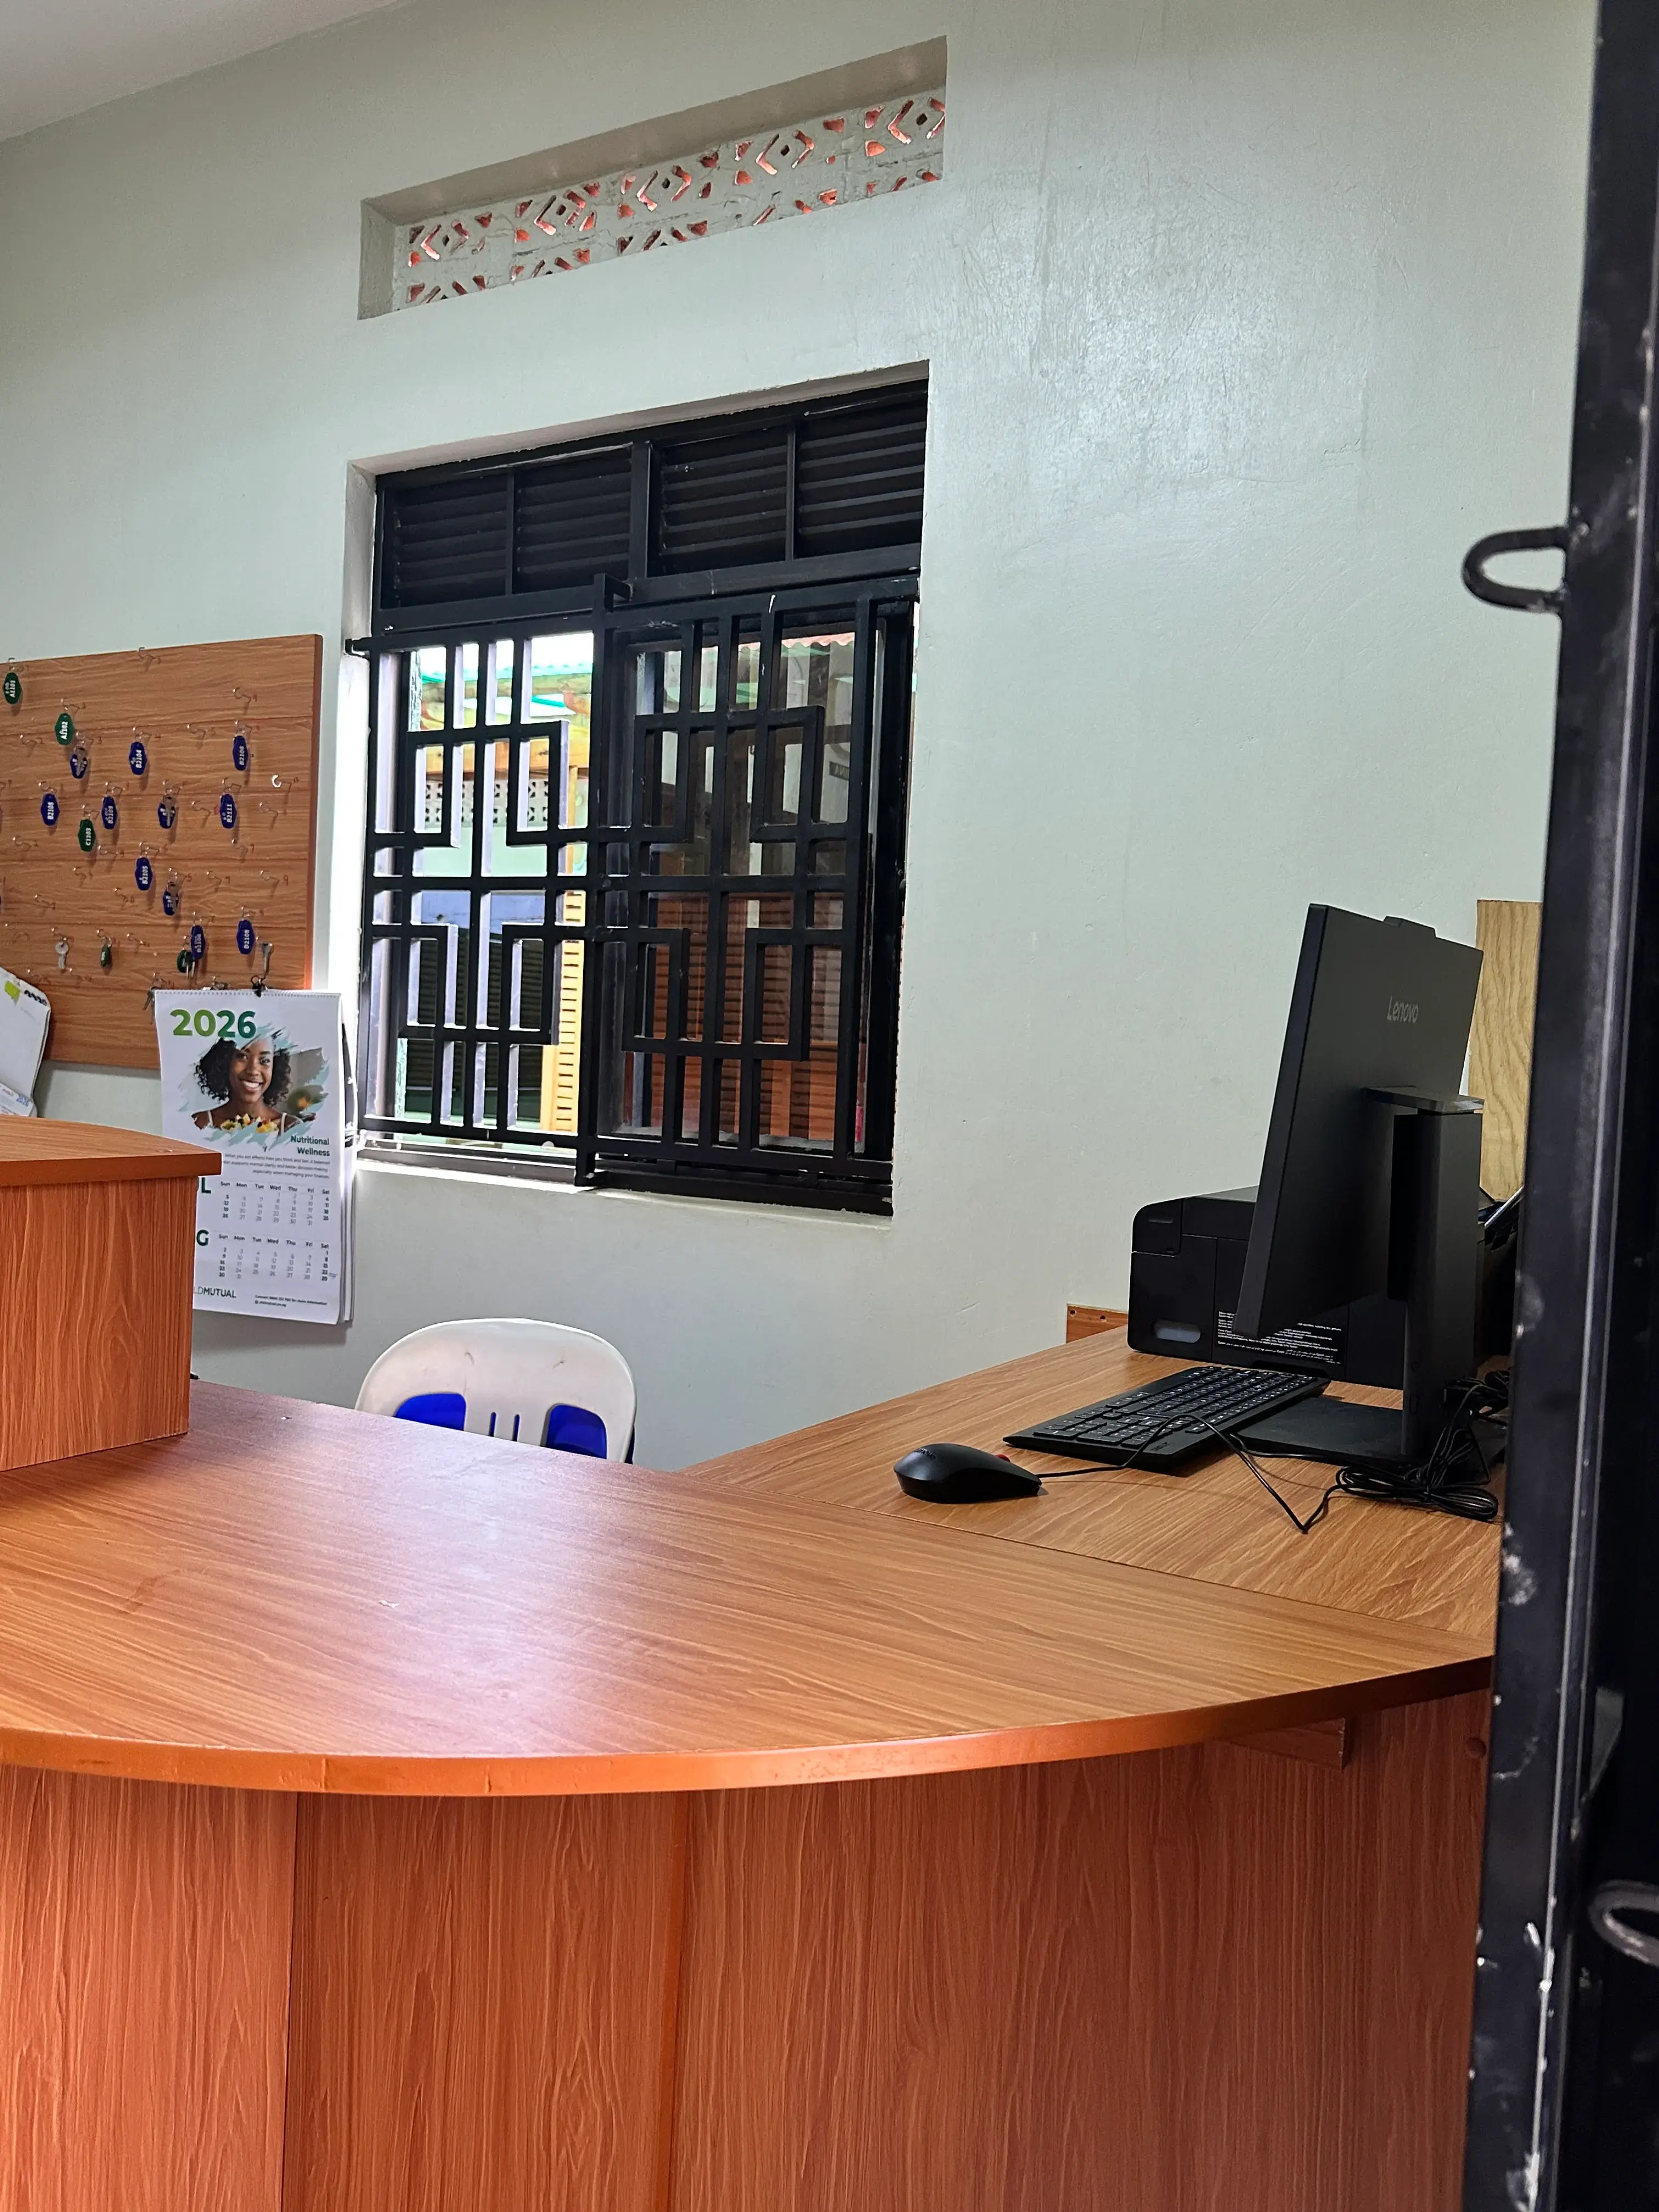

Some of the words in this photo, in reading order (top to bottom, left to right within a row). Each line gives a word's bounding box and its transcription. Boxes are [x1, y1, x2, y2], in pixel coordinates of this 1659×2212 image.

[283, 874, 289, 886] 9
[1386, 995, 1419, 1023] Lenovo
[170, 1009, 256, 1039] 2026
[291, 1135, 330, 1145] Nutritional
[297, 1147, 330, 1156] Wellness
[198, 1177, 212, 1194] L
[194, 1286, 236, 1298] LDMUTUAL
